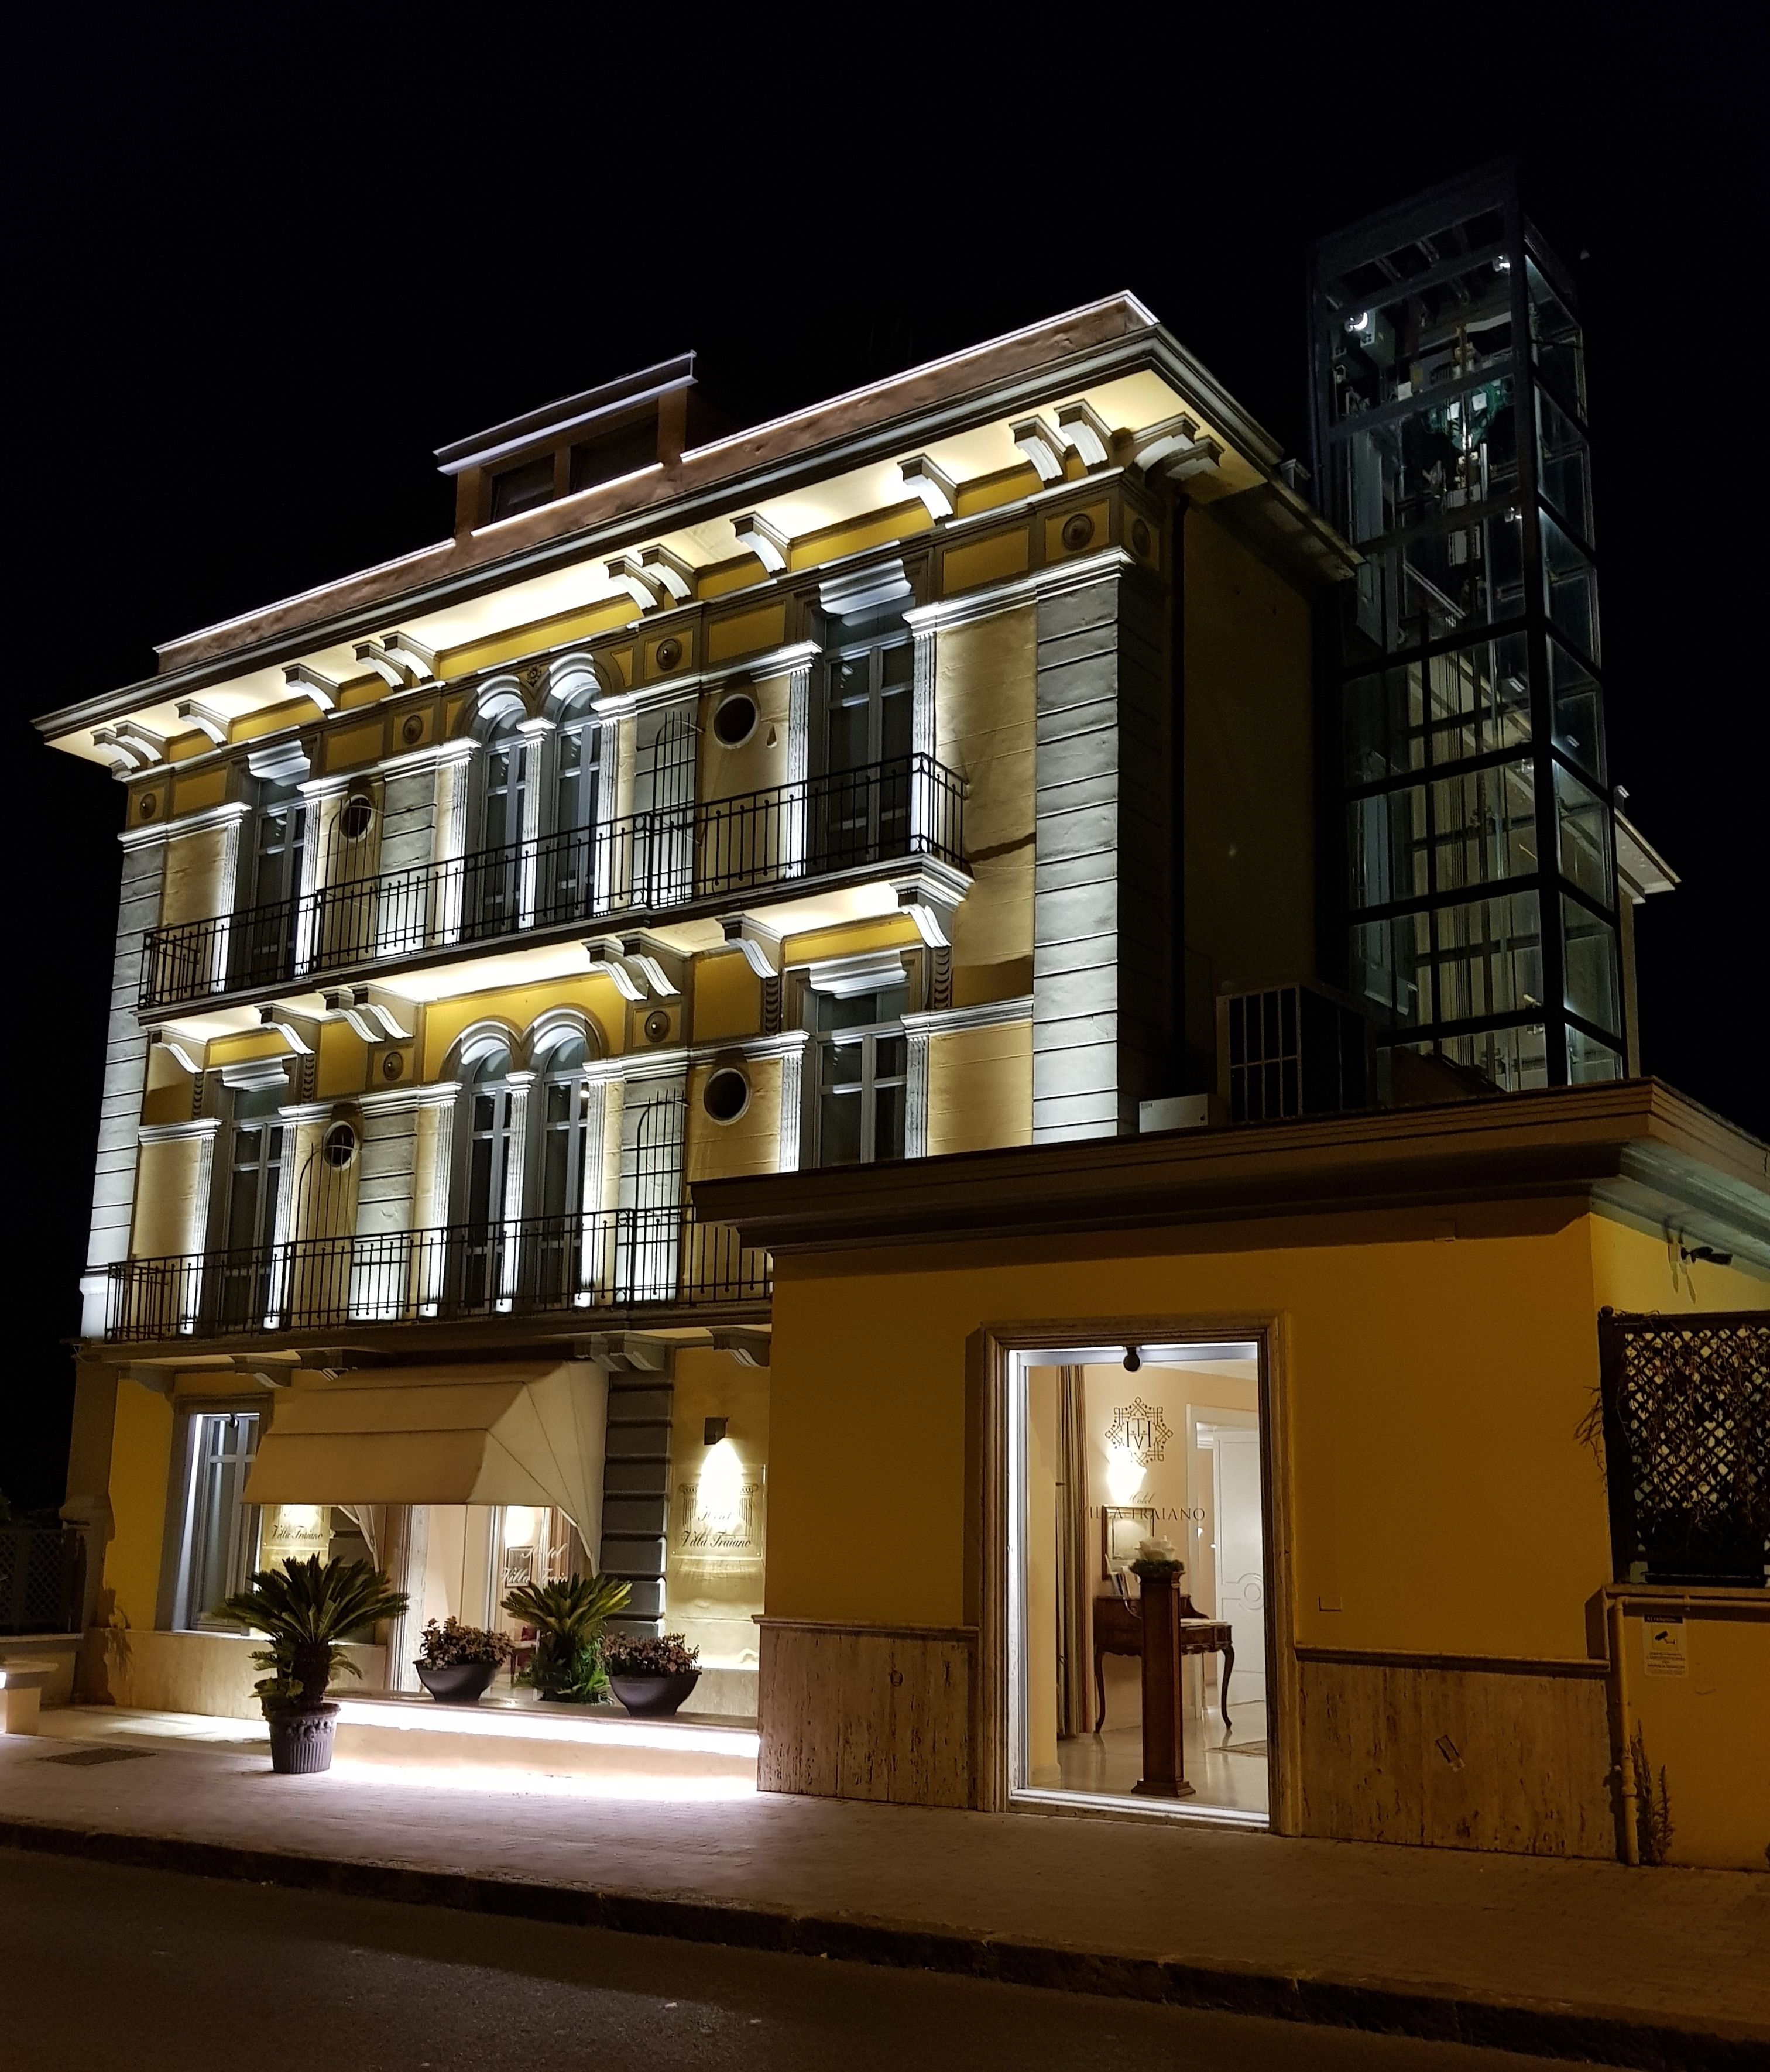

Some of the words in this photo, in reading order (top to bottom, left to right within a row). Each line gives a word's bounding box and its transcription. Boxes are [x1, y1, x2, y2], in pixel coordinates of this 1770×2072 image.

[1079, 1506, 1123, 1519] ILA
[1128, 1507, 1205, 1521] TRAIANO
[272, 1524, 290, 1540] Villa
[291, 1525, 323, 1541] Traiano
[680, 1530, 708, 1548] Villa
[709, 1531, 752, 1548] Traiano
[502, 1567, 530, 1583] Villa
